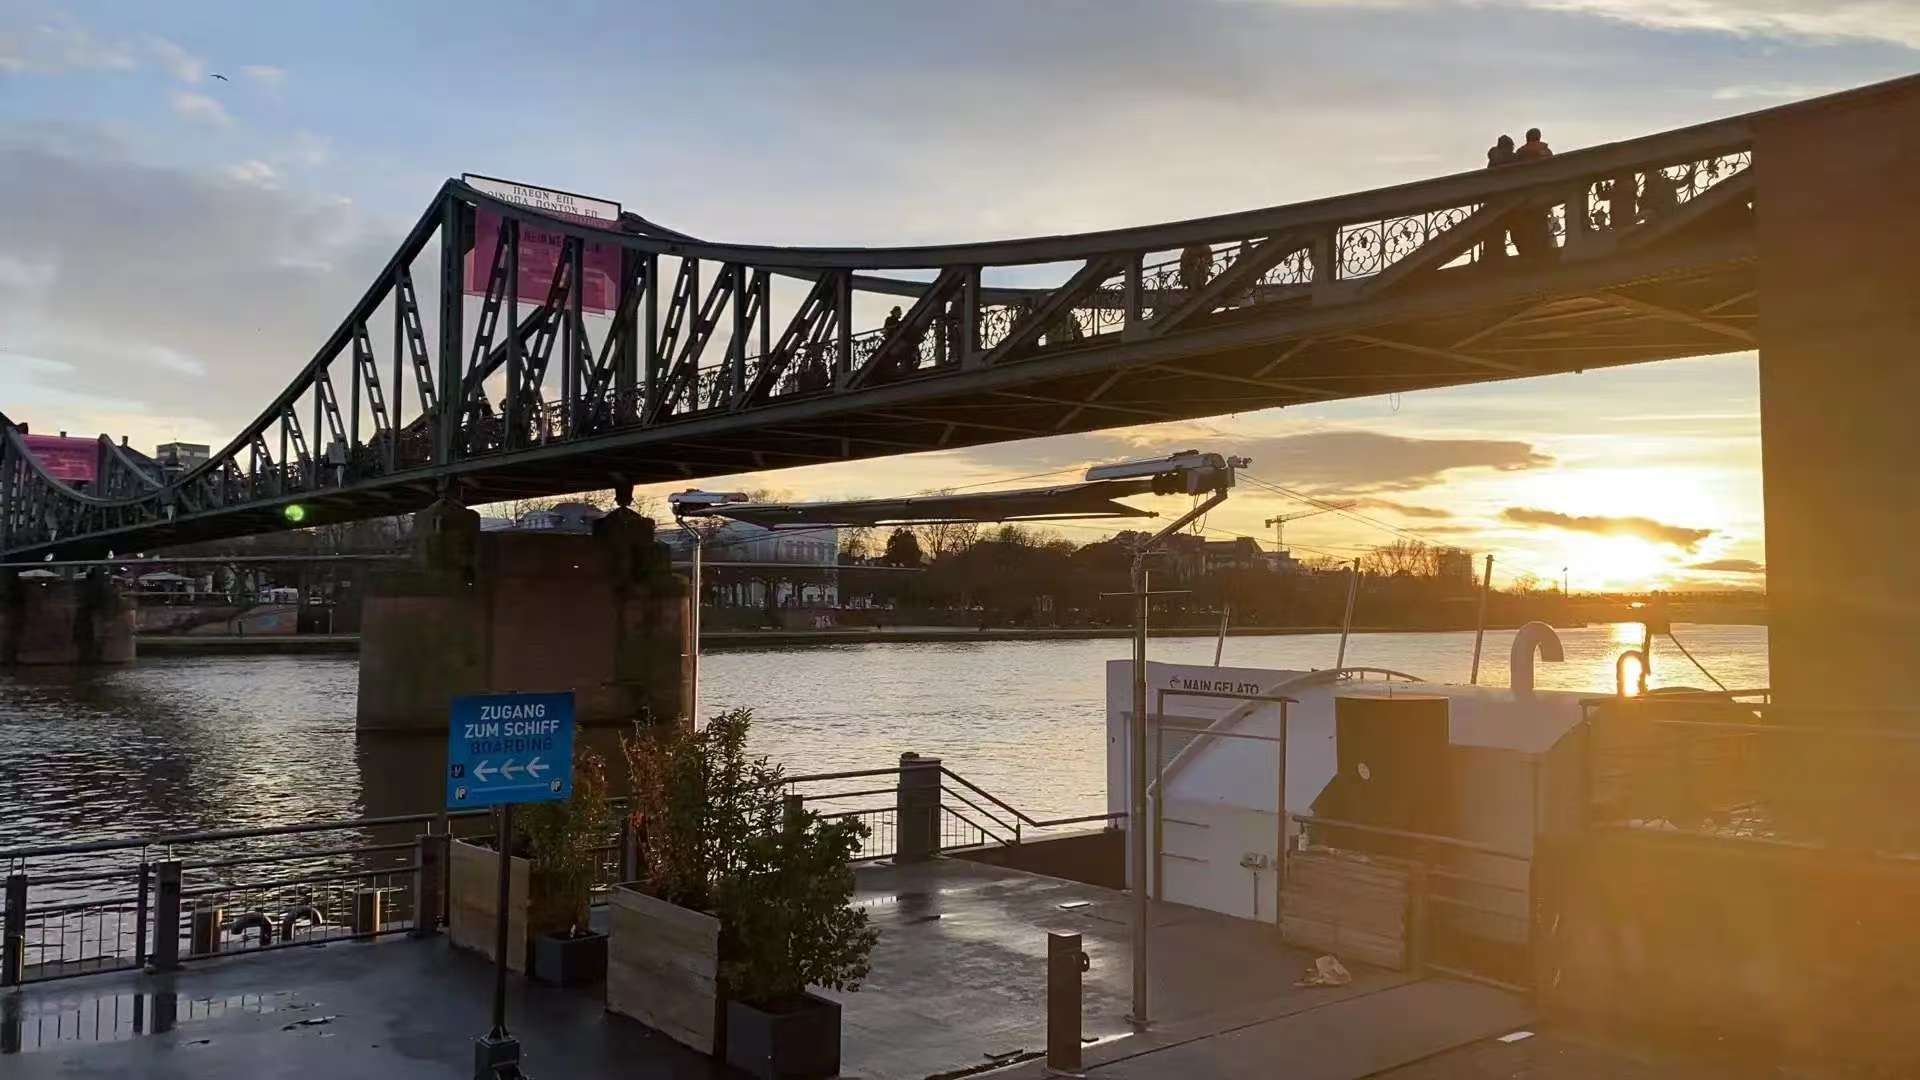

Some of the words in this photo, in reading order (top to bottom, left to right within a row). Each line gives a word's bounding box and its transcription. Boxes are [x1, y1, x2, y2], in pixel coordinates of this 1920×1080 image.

[1184, 680, 1211, 691] MAIN
[480, 704, 545, 720] ZUGANG
[464, 724, 498, 739] ZUM
[504, 720, 560, 736] SCHIFF
[471, 737, 553, 753] BOARDING
